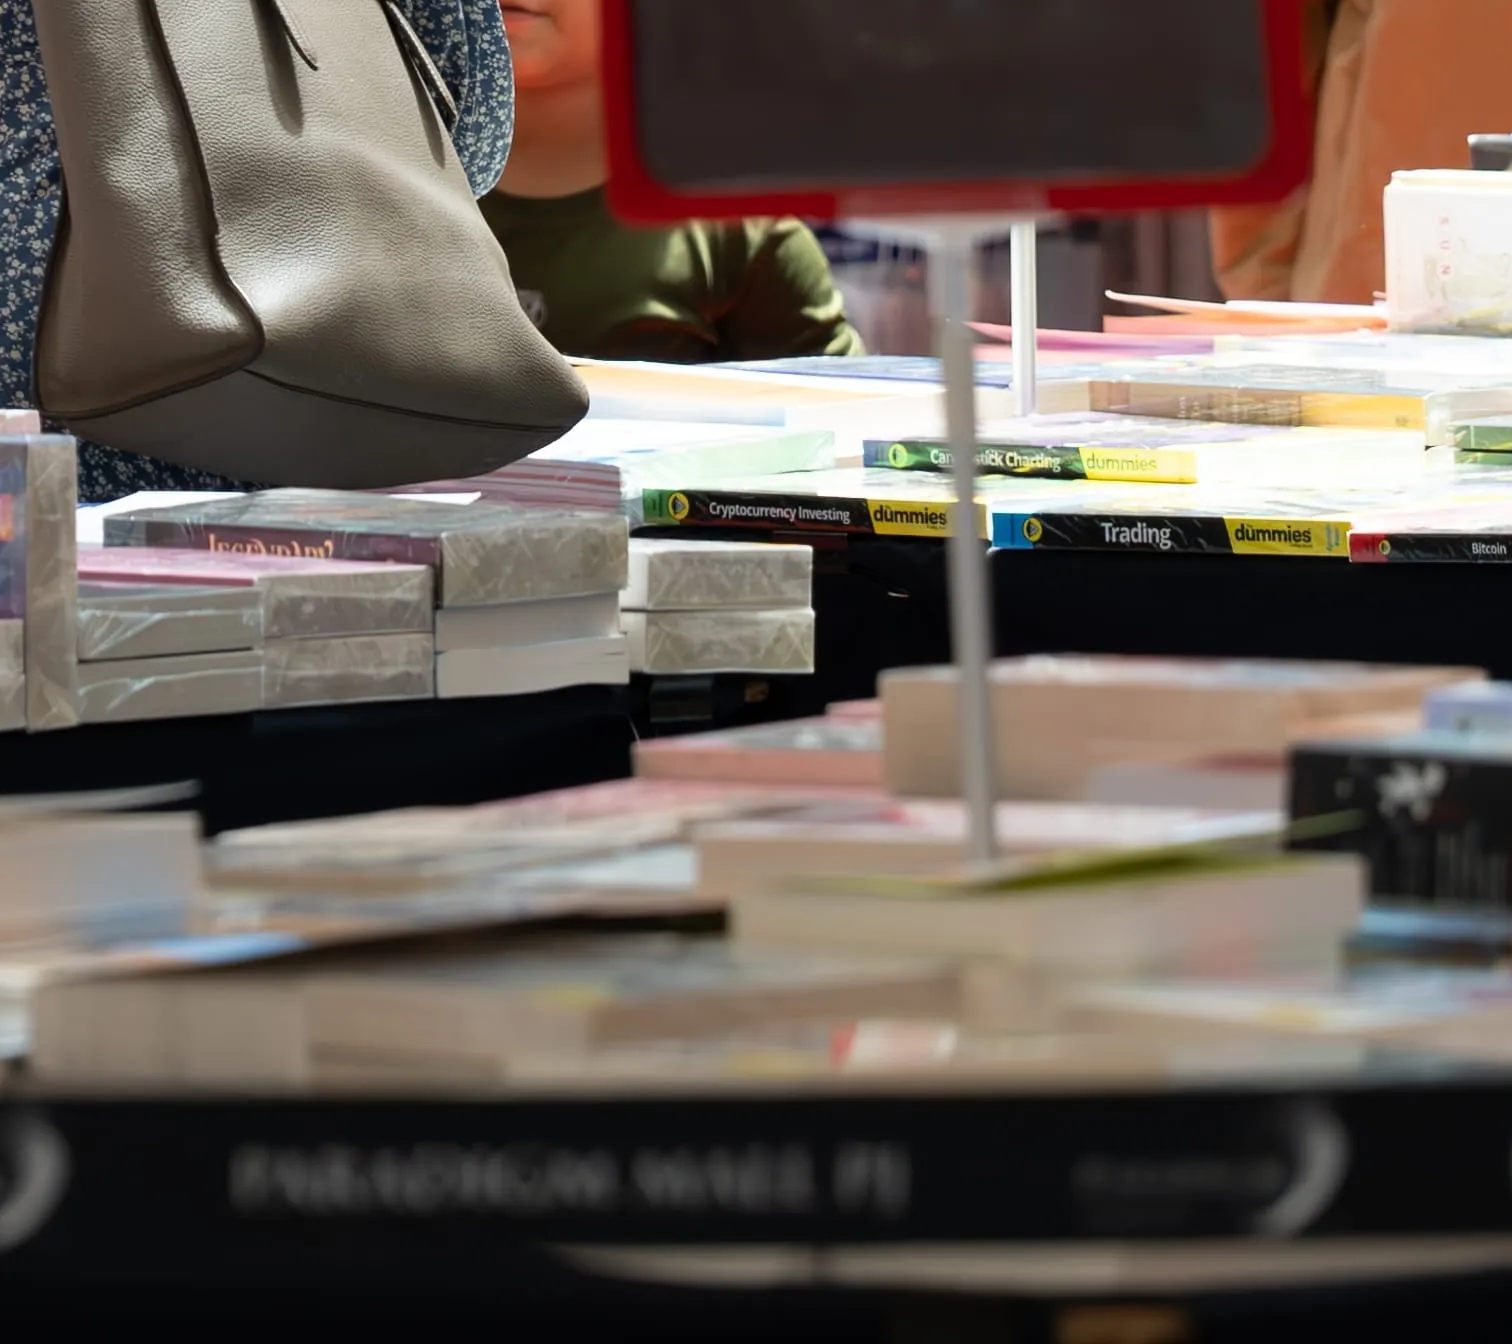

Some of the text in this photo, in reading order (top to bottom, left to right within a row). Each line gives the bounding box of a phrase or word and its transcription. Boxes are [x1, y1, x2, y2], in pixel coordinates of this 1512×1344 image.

[930, 449, 1158, 472] Canstick Charting dummies
[709, 501, 948, 526] Cryptocurrency Investing dummies
[1101, 522, 1312, 550] Trading dummies
[1471, 541, 1507, 556] Bitcoin
